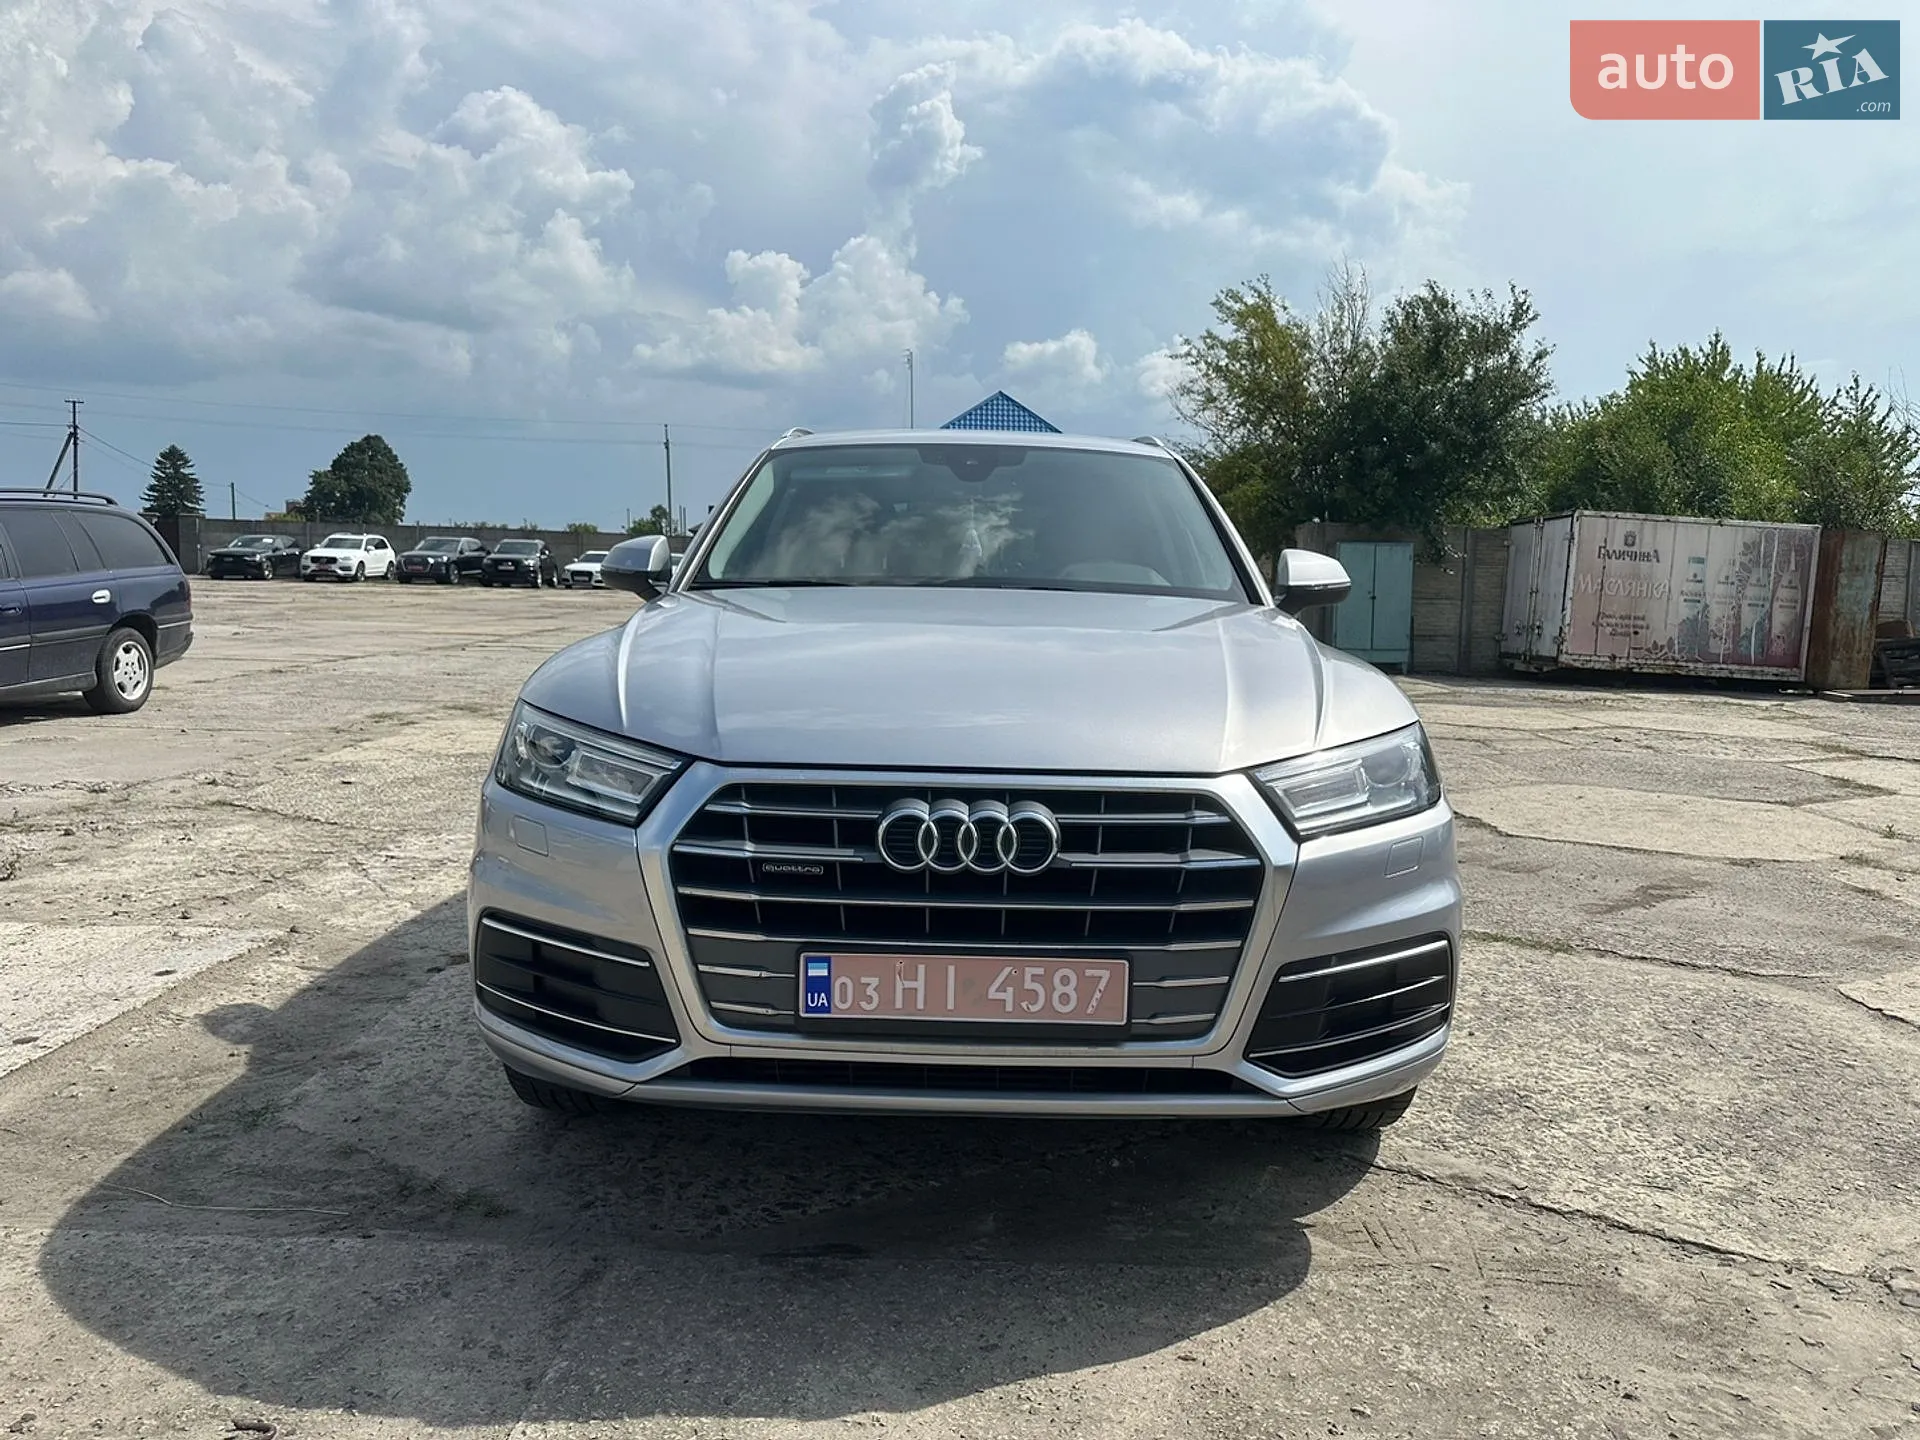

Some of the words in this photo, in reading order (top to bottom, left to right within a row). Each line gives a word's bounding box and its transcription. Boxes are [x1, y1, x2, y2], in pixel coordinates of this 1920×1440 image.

[764, 863, 822, 874] quattro
[833, 975, 880, 1011] 03
[987, 966, 1111, 1015] 4587
[807, 992, 828, 1008] UA
